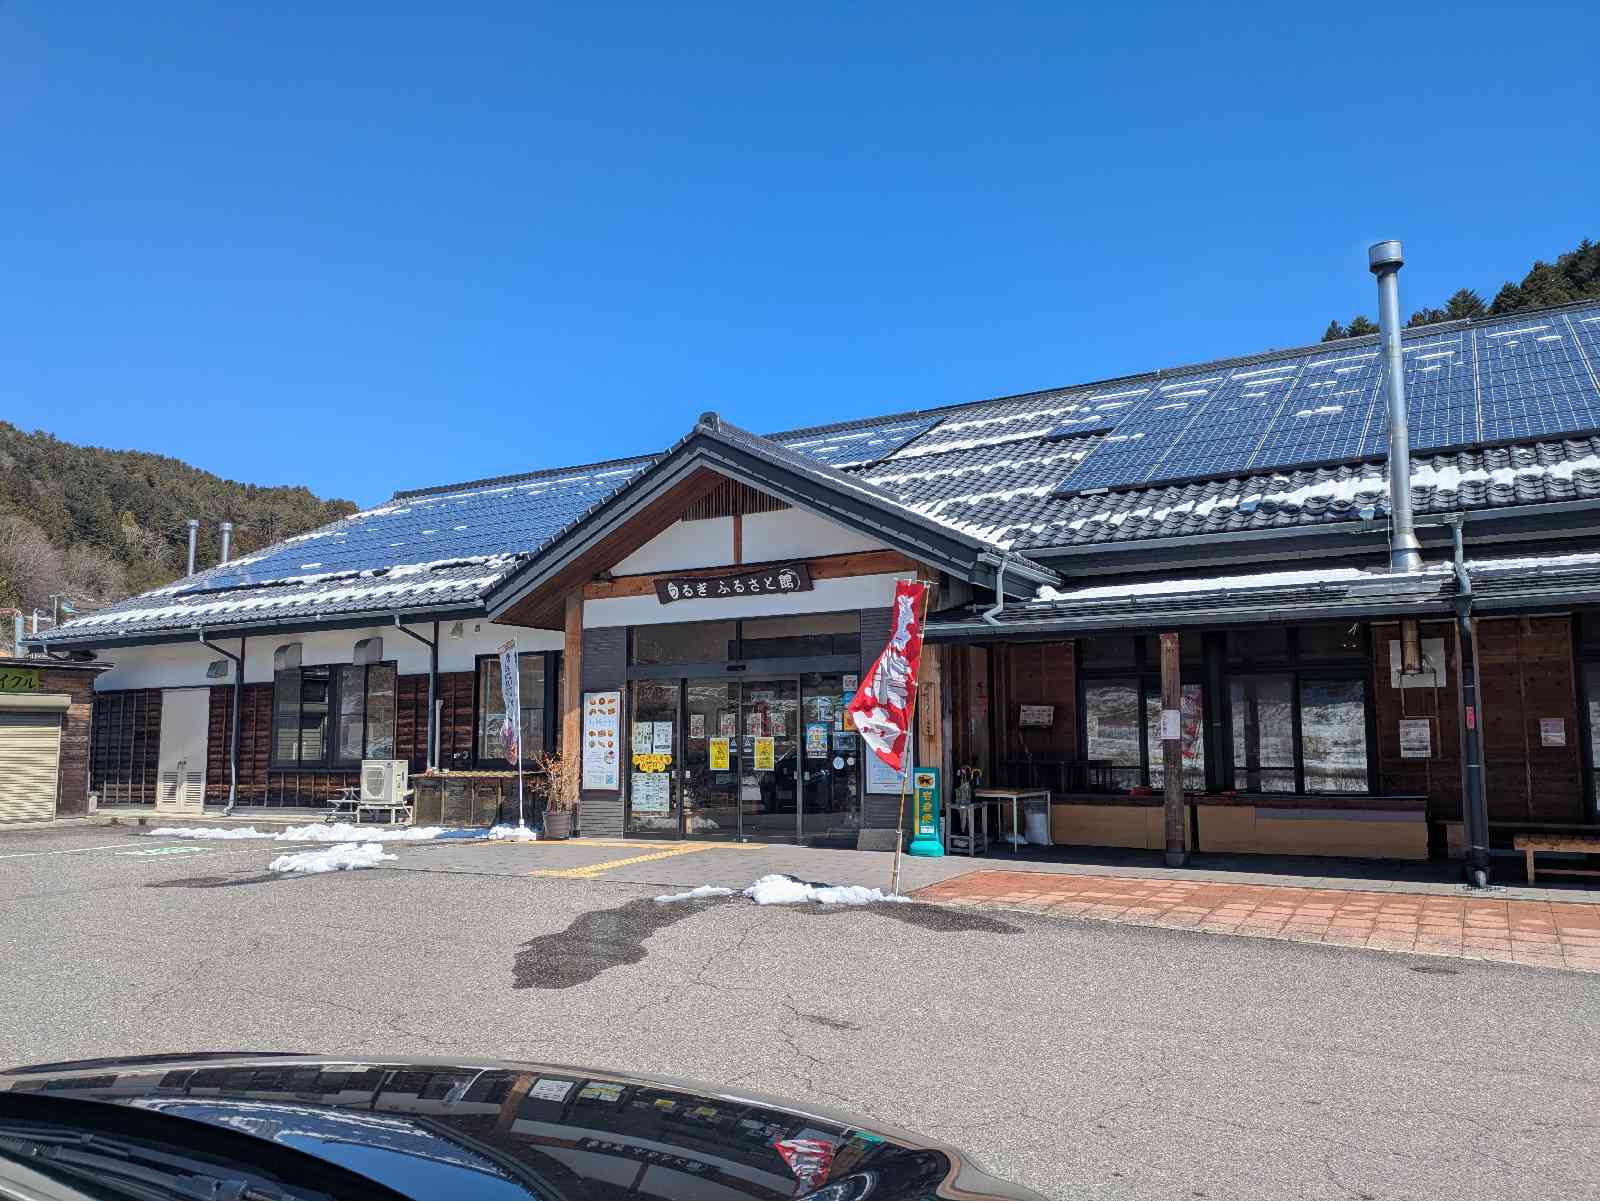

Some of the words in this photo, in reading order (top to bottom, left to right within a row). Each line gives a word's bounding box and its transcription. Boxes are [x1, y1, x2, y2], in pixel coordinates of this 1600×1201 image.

[718, 571, 799, 594] ふるさと館
